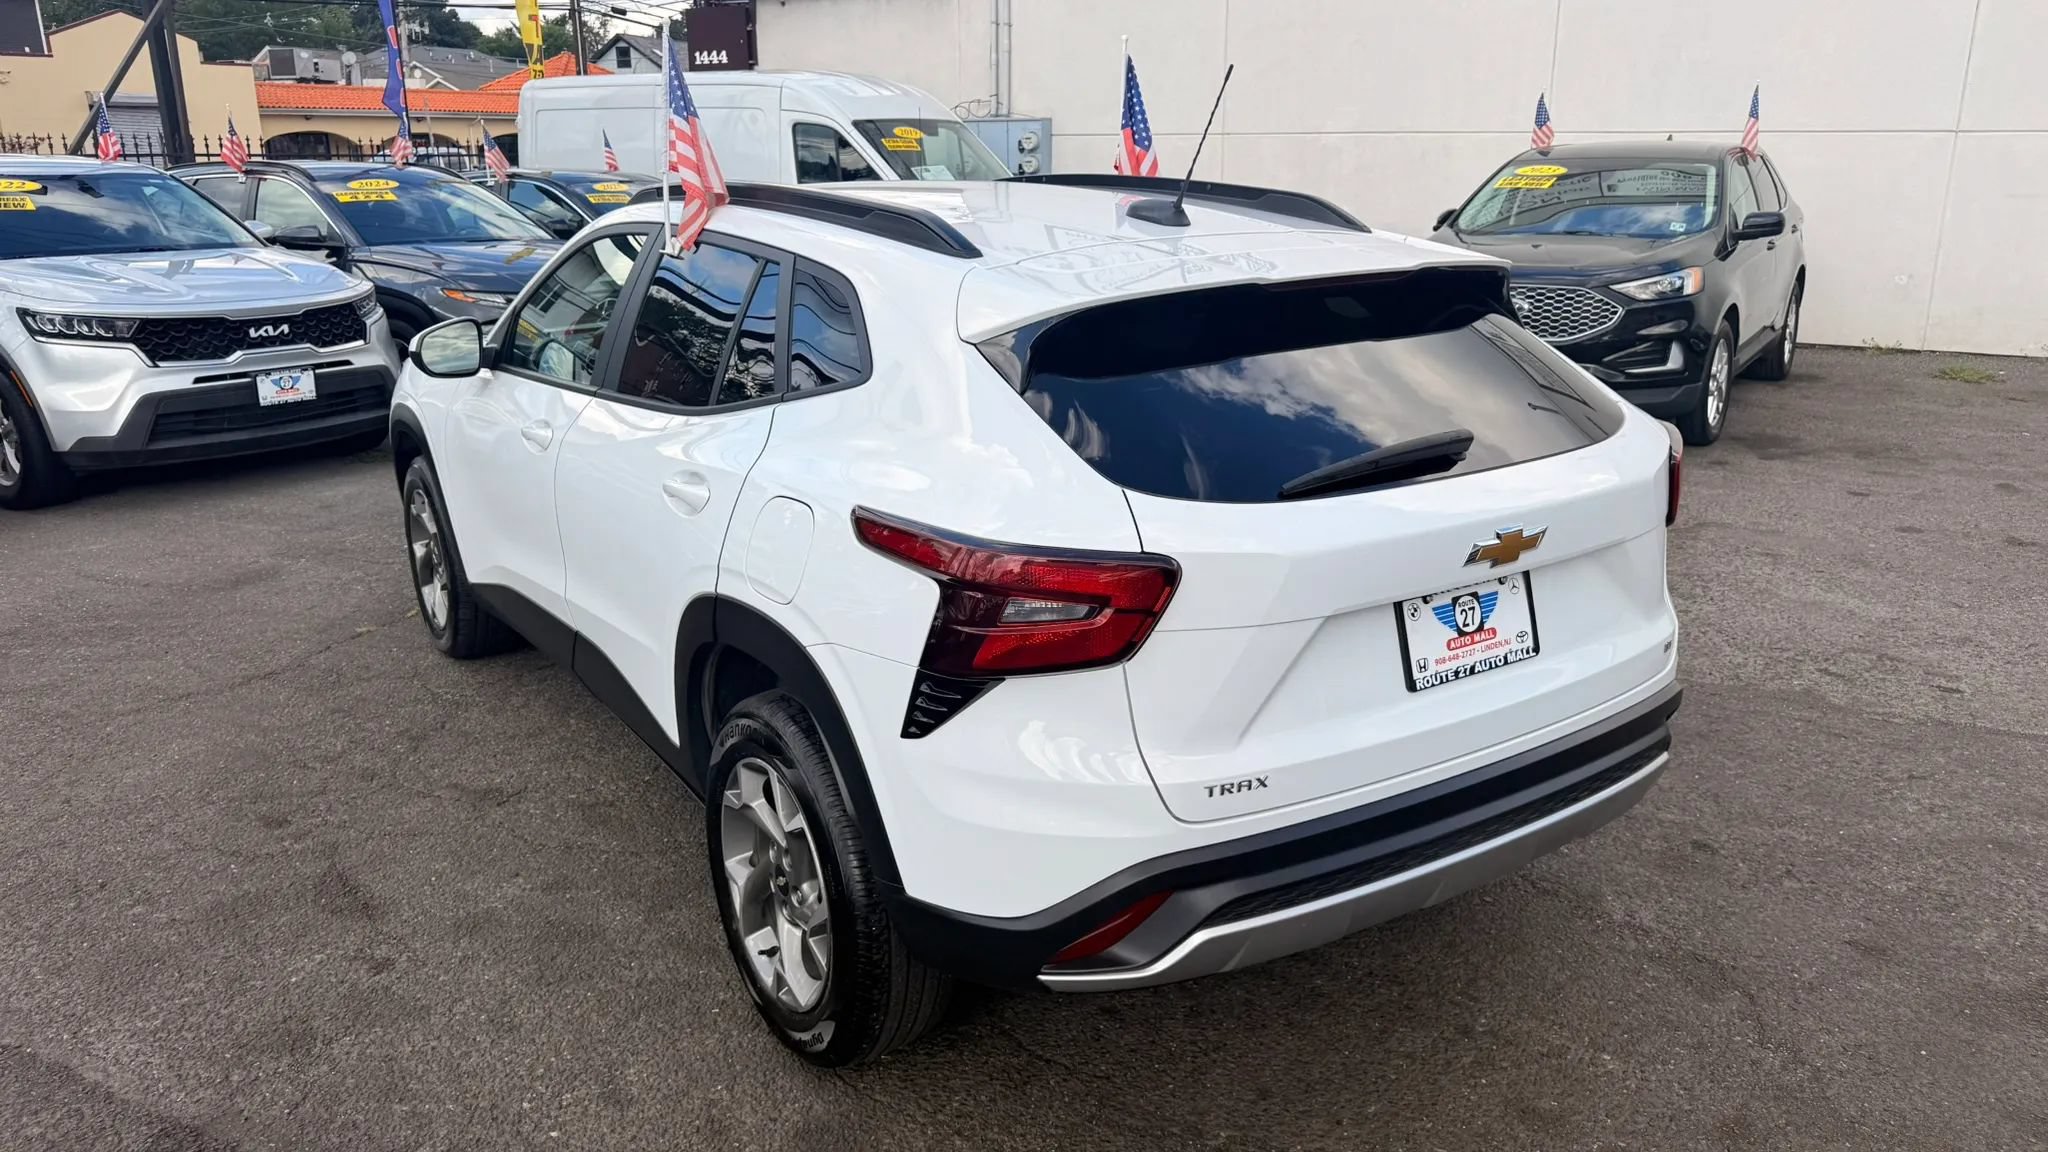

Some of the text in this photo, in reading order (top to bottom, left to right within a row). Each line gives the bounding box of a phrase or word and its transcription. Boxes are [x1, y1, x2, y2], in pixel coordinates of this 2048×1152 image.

[694, 50, 728, 64] 1444
[0, 181, 26, 189] 22
[249, 324, 289, 338] KIA
[1457, 598, 1475, 608] ROUTE
[1460, 606, 1476, 628] 27
[1450, 631, 1495, 649] AUTO MALL
[1434, 649, 1476, 667] 908-648-2727
[1480, 638, 1512, 653] LINDEN,NJ
[1415, 648, 1536, 690] ROUTE 27 AUTO MALL
[1203, 776, 1268, 798] TRAX
